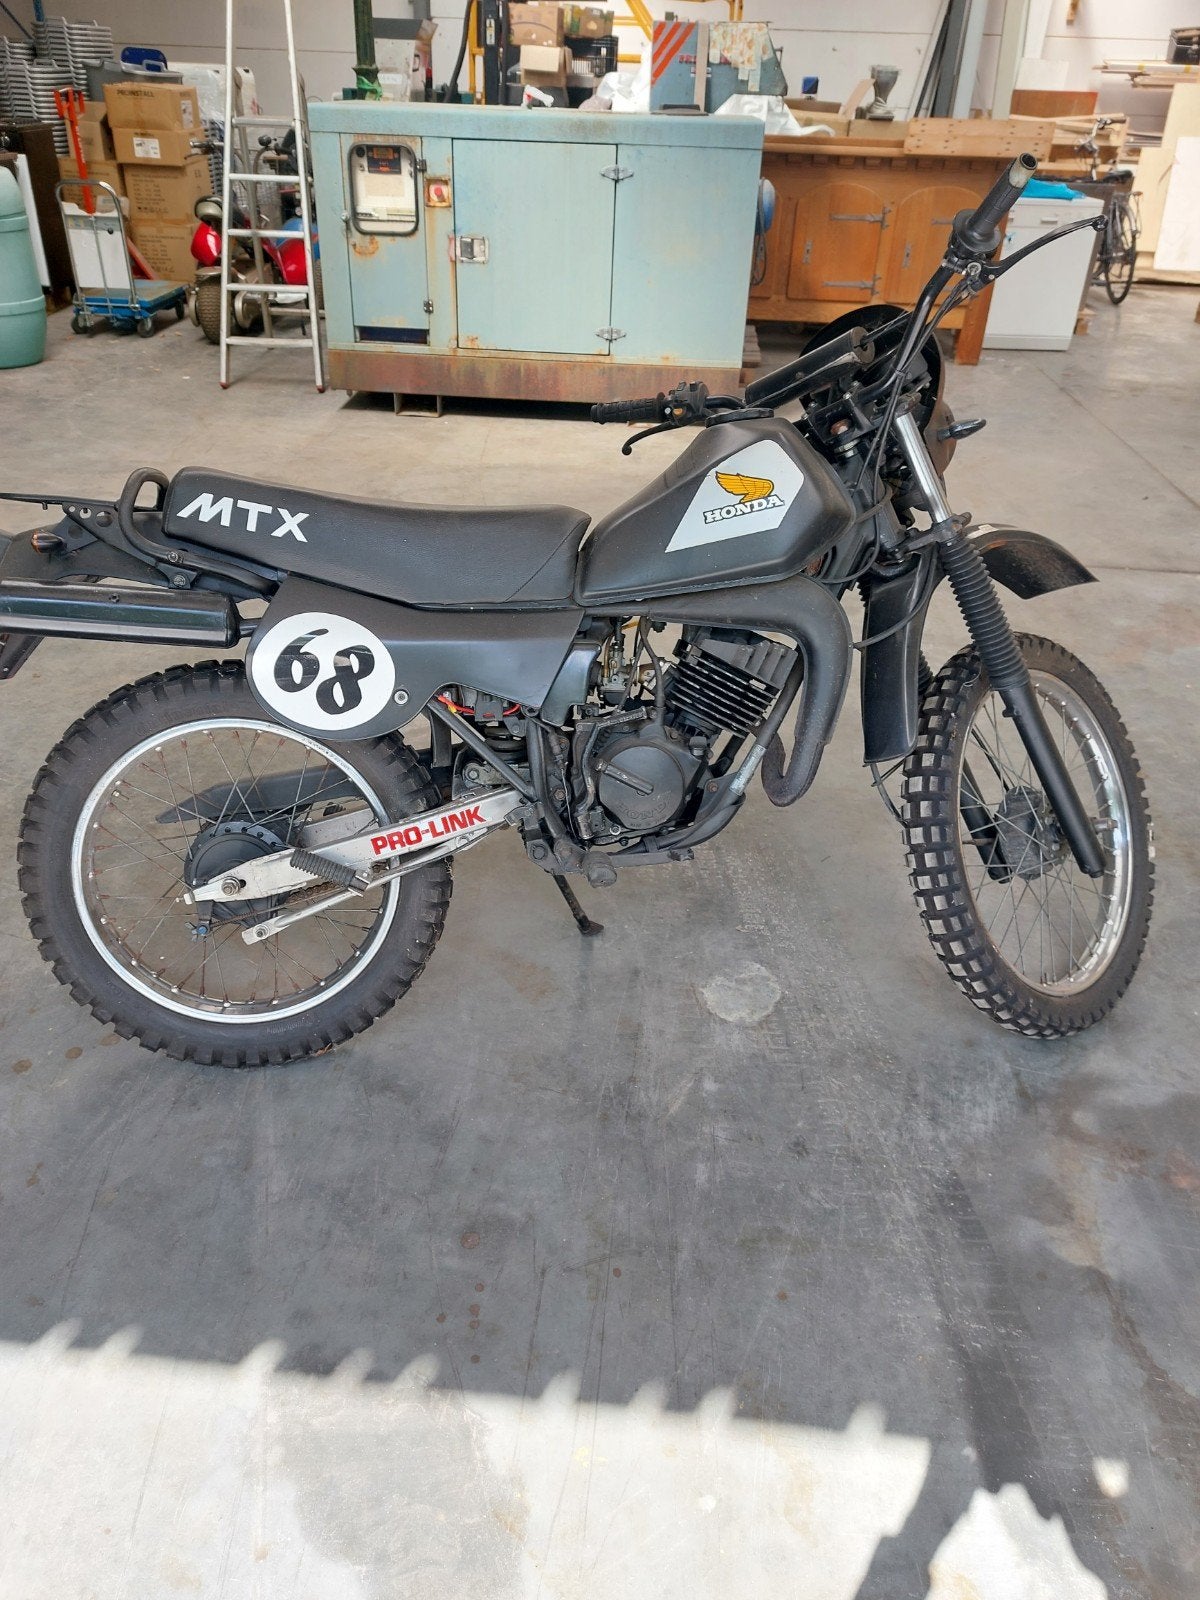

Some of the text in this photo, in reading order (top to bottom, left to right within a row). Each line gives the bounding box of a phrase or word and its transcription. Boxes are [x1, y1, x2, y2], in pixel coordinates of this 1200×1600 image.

[176, 492, 310, 543] MTX
[703, 494, 785, 524] HONDA
[273, 628, 375, 716] 68
[370, 805, 487, 856] PRO-LINK
